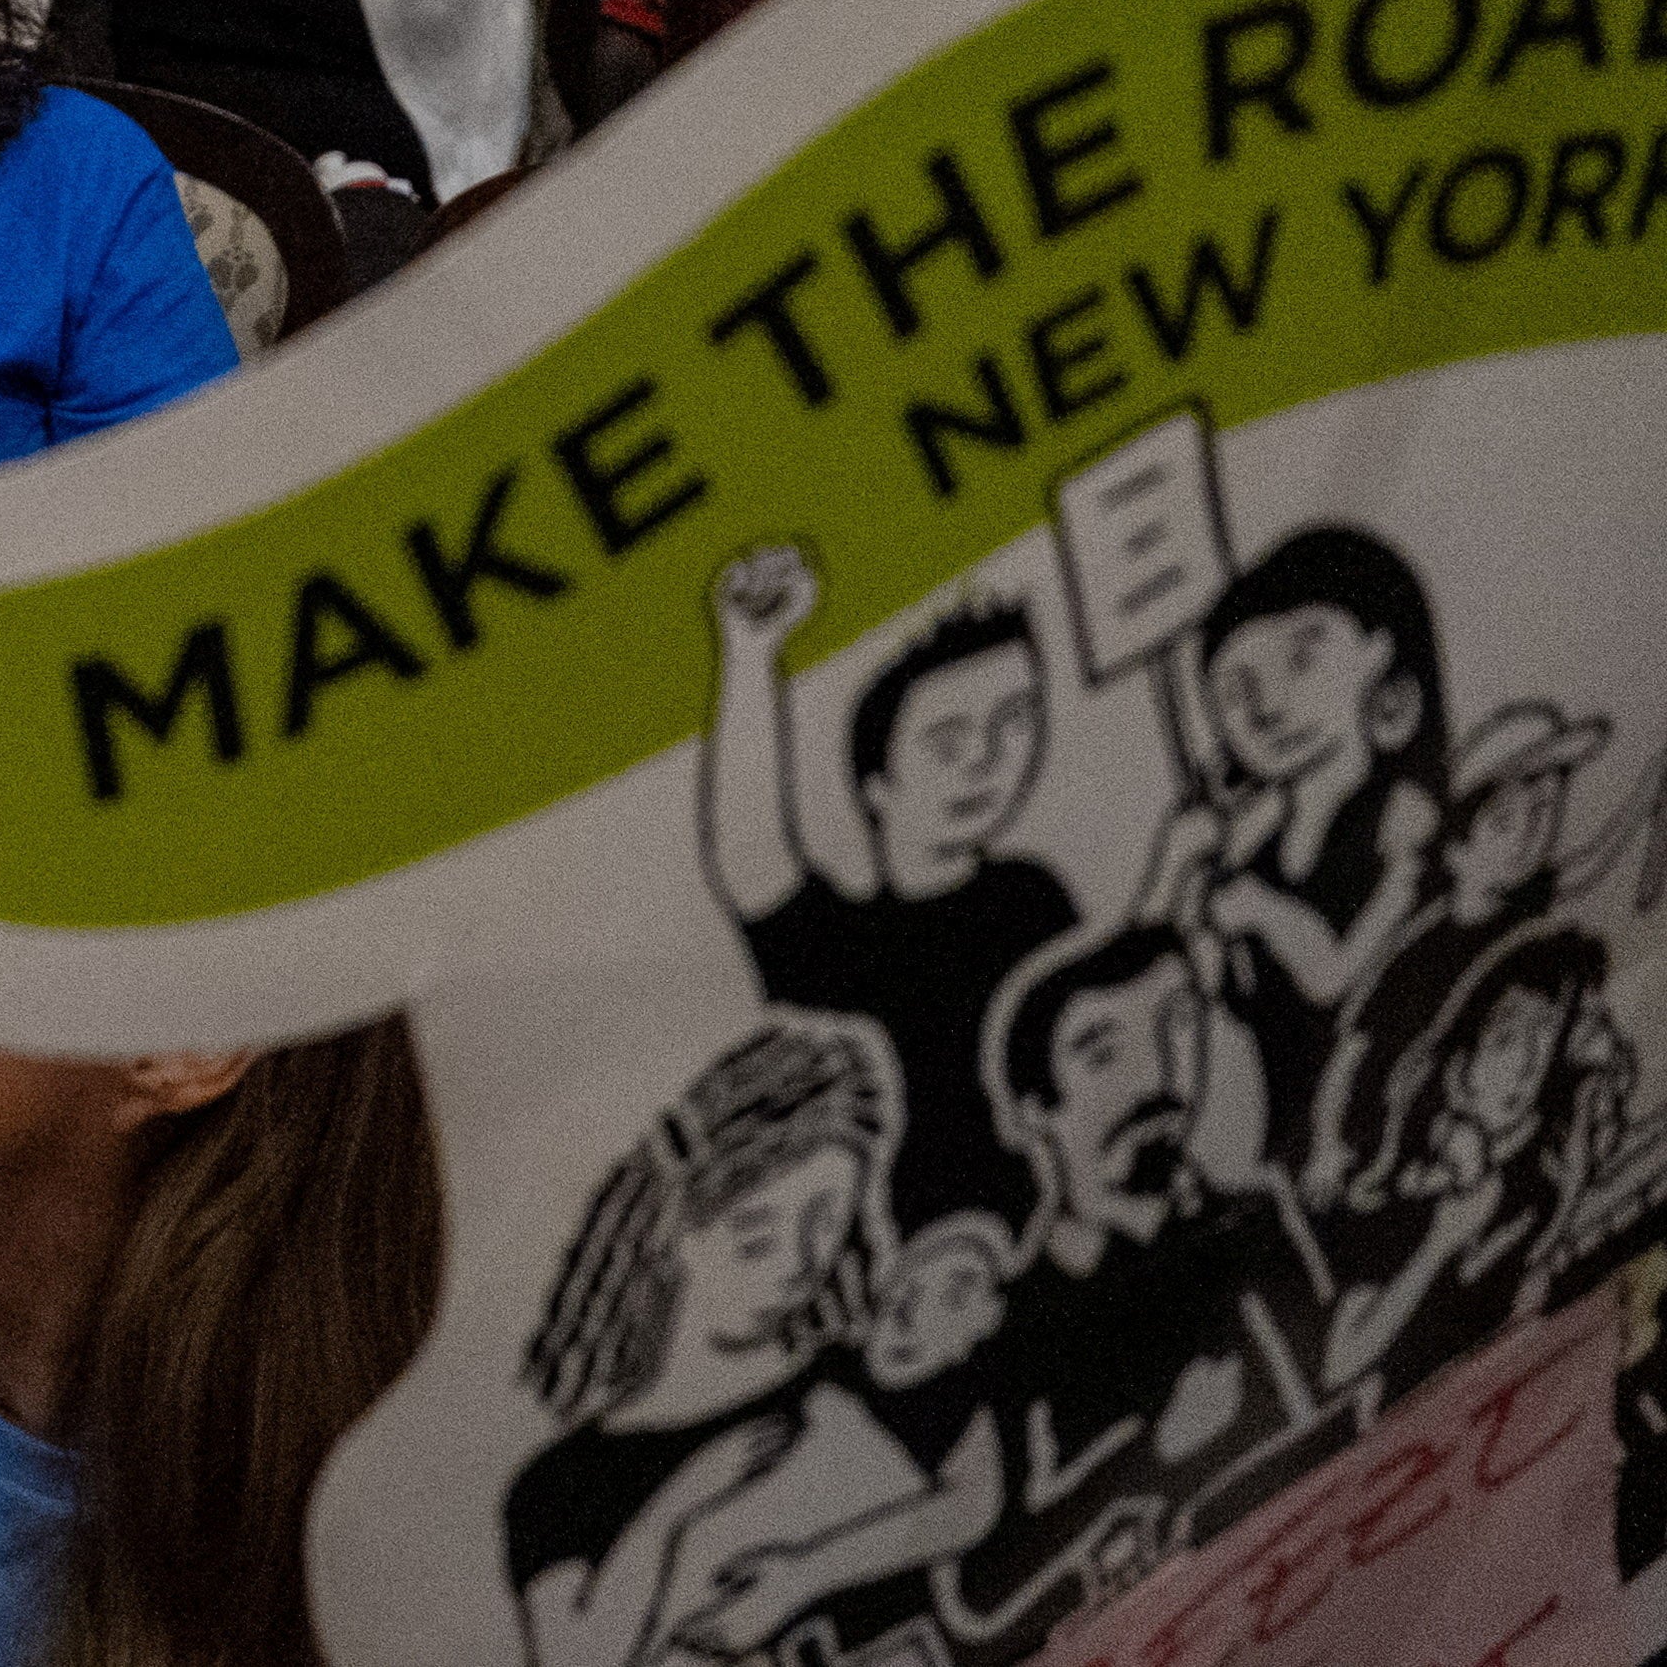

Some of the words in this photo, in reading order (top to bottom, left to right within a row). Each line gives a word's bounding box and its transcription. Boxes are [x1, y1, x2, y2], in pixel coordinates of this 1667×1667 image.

[66, 378, 710, 806] MAKE
[710, 57, 1146, 412] THE
[900, 207, 1281, 502] NEW
